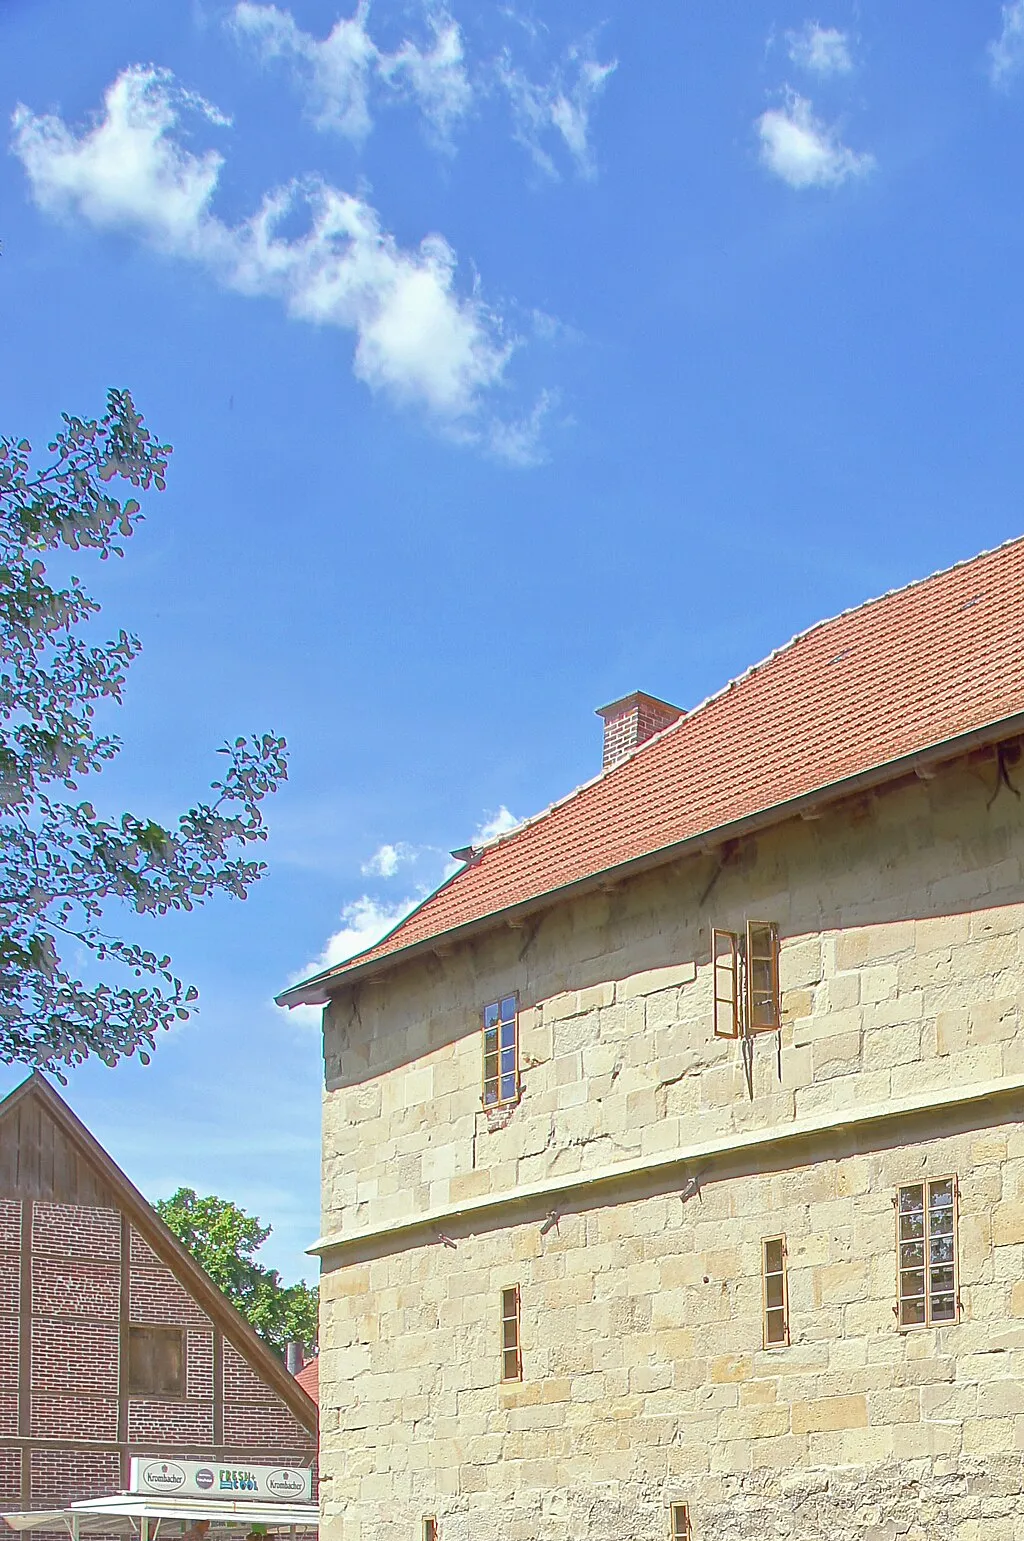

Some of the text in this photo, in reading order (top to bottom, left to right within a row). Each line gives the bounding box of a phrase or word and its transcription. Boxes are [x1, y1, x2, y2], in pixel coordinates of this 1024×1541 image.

[147, 1472, 183, 1484] Krombacher
[233, 1480, 259, 1491] COOL
[269, 1479, 302, 1491] Krombacher
